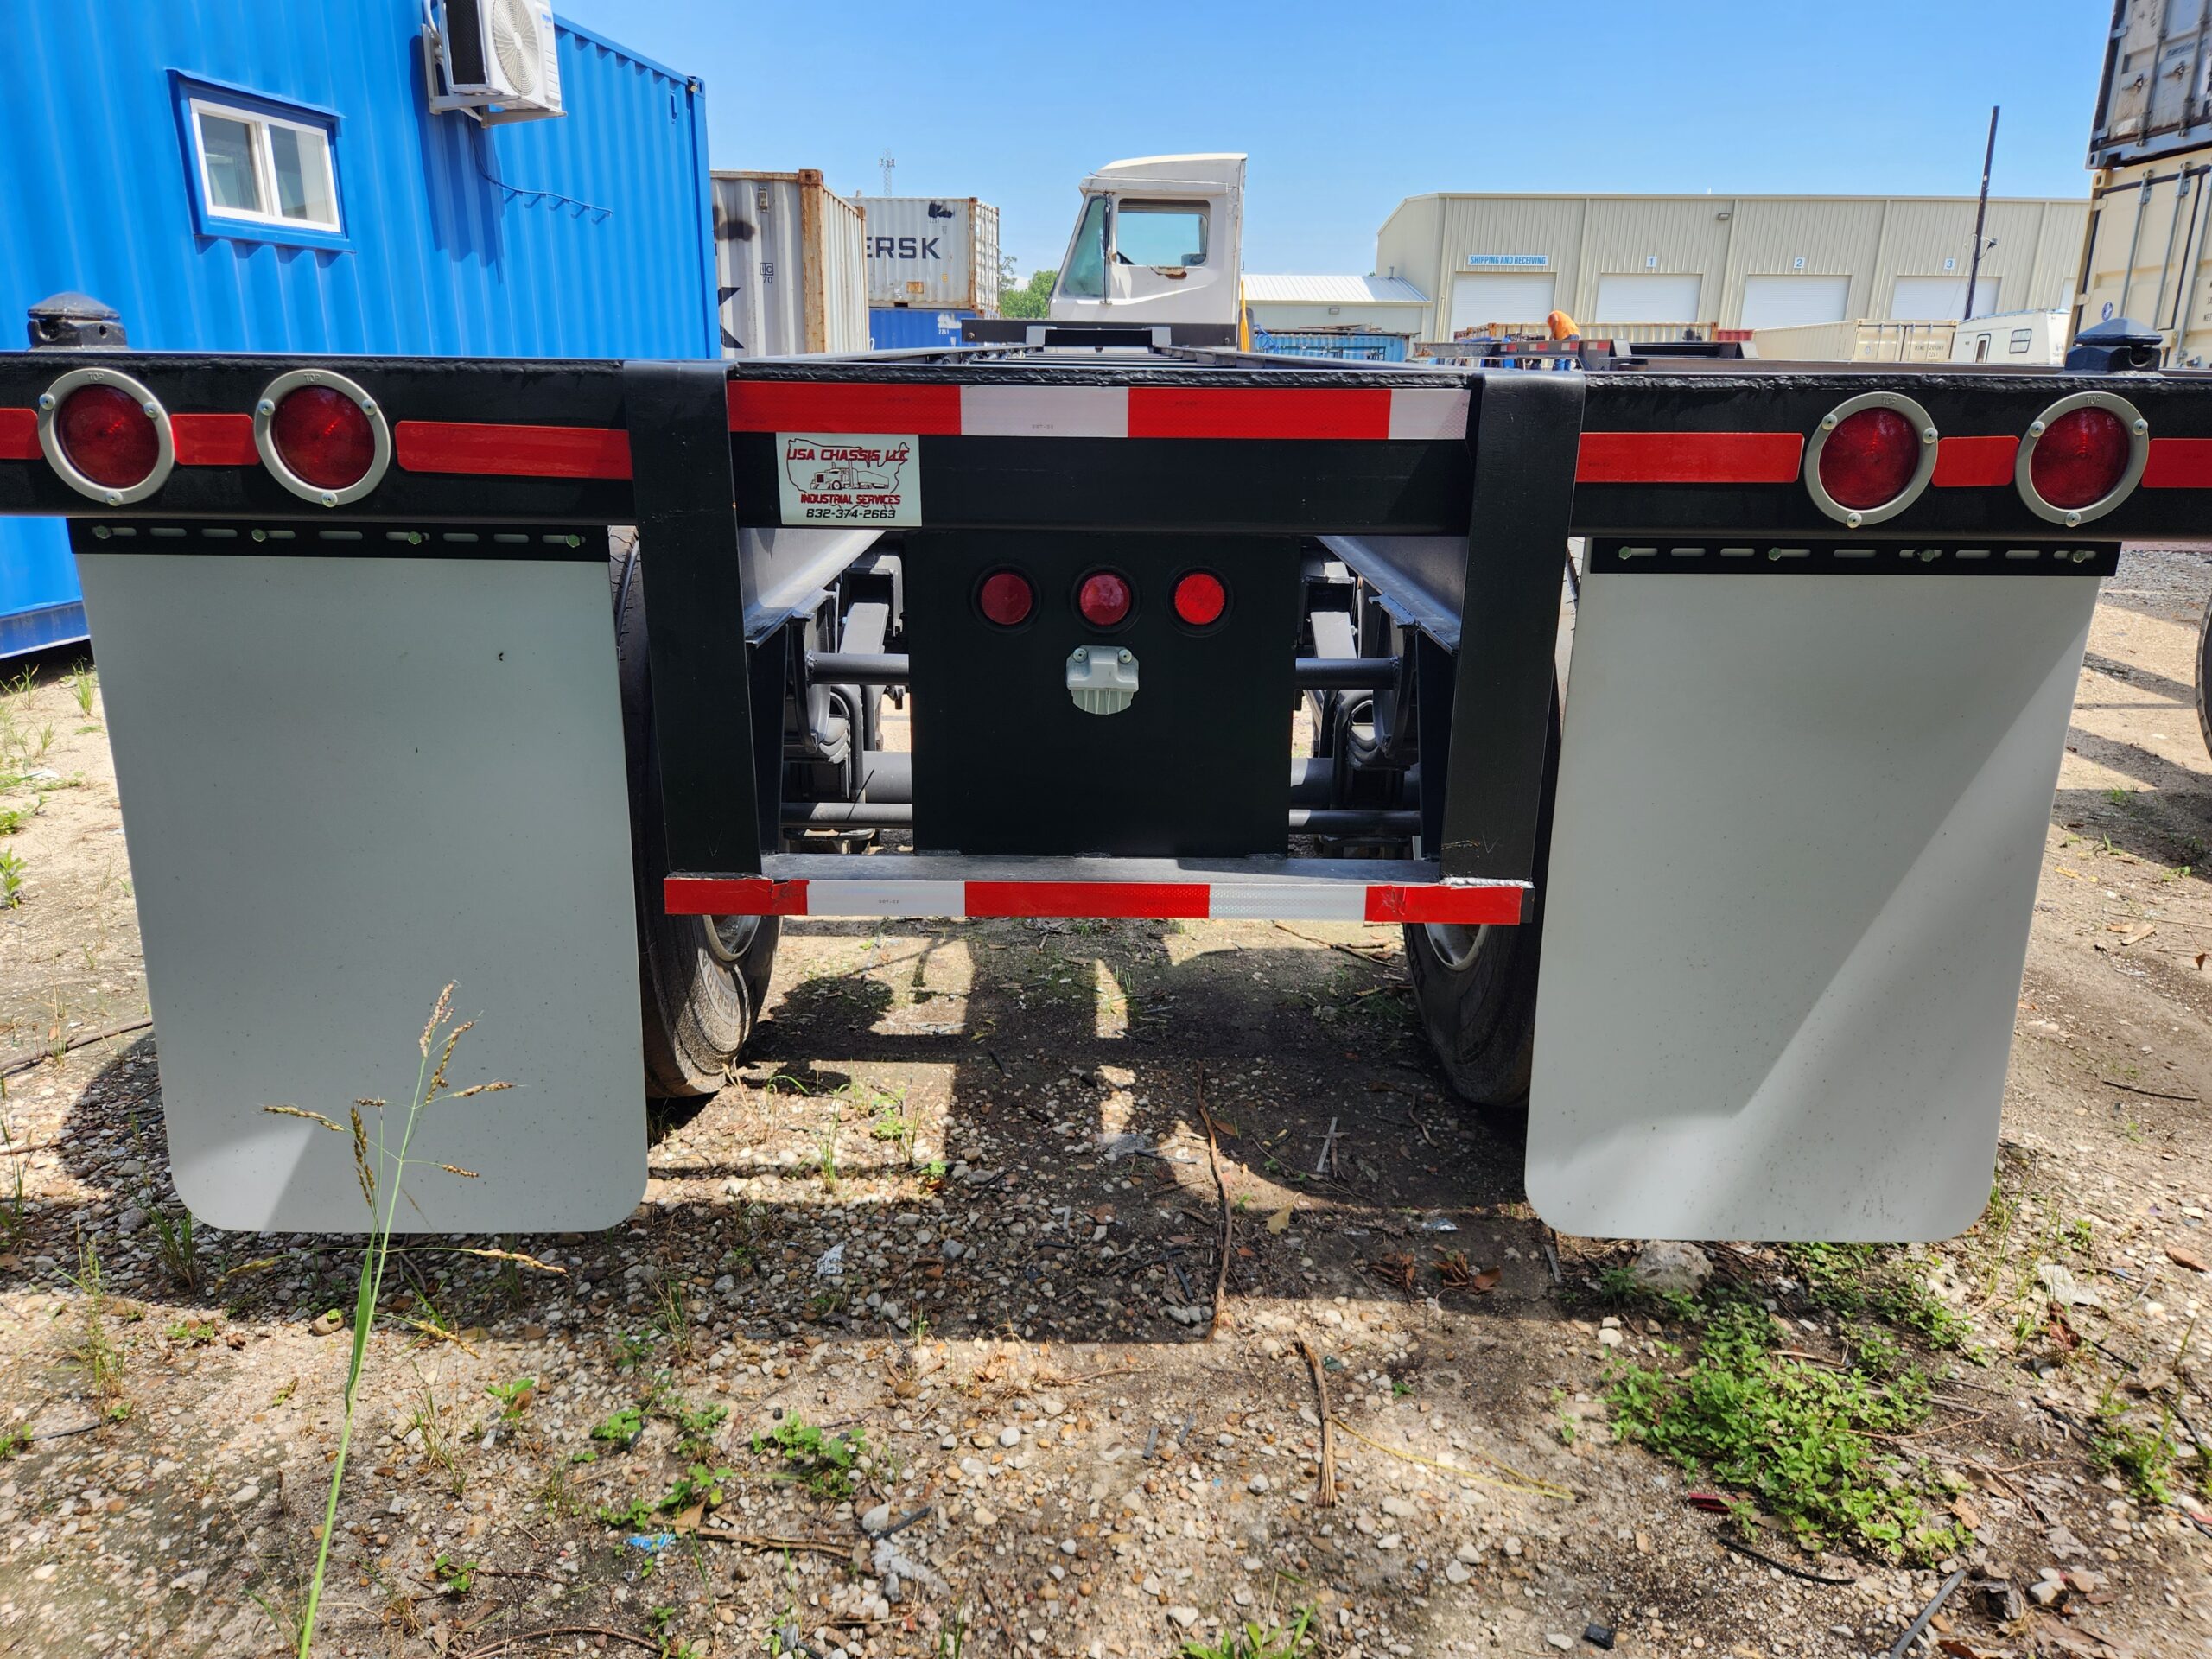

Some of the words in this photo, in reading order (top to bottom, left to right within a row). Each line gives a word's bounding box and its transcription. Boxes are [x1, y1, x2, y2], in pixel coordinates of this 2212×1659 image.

[1470, 256, 1499, 264] SHIPPING
[1500, 256, 1513, 264] AND
[1514, 257, 1546, 265] RECEIVING
[1796, 259, 1803, 268] 2
[1946, 260, 1954, 269] 3
[762, 276, 773, 284] 70
[87, 372, 105, 381] TOP
[303, 372, 321, 383] TOP
[1881, 396, 1897, 405] TOP
[2086, 395, 2102, 404] TOP
[787, 448, 815, 461] USA
[821, 448, 881, 461] CHASSIS
[885, 448, 909, 461] LLC
[800, 493, 853, 505] INDUSTRIAL
[855, 494, 901, 505] SERVICES
[806, 508, 897, 519] 832-374-2663
